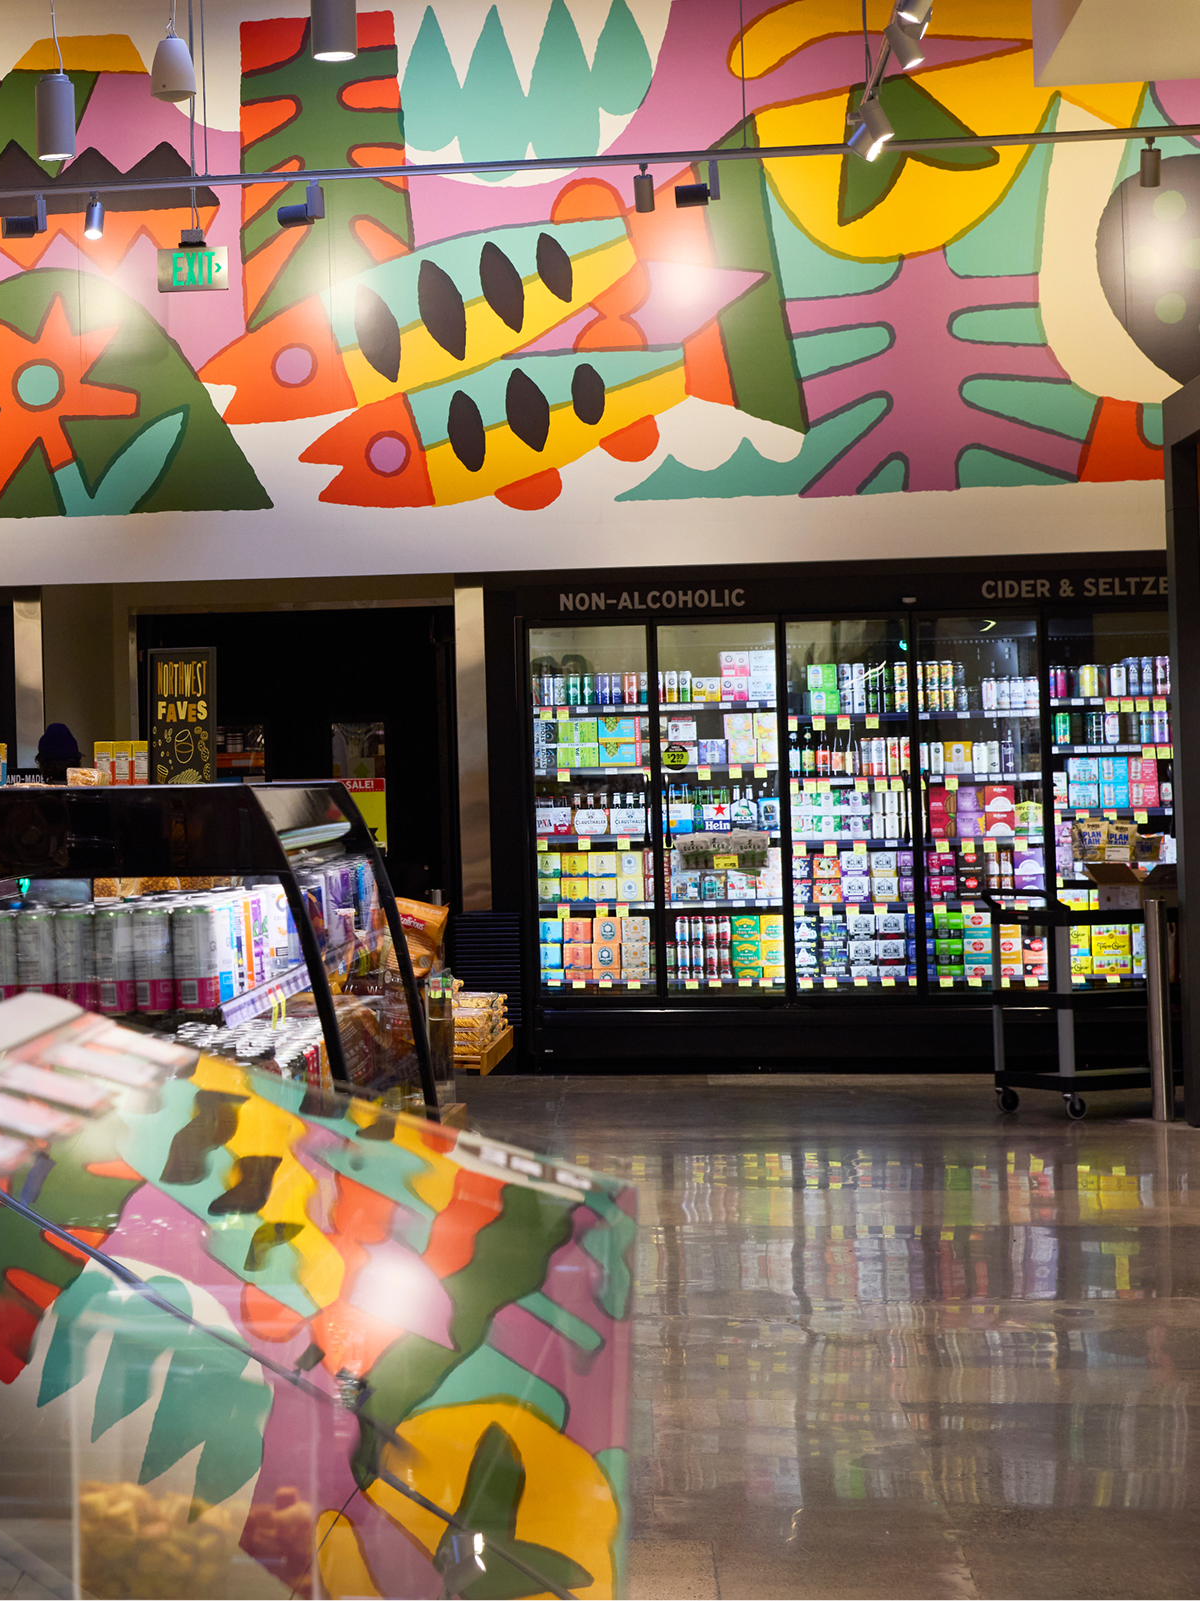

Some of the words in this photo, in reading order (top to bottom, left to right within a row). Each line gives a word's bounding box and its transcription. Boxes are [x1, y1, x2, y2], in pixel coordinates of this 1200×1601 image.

[172, 251, 215, 286] EXIT
[981, 579, 1051, 599] CIDER
[1058, 578, 1075, 598] &
[1083, 576, 1169, 597] SELTZE
[559, 588, 746, 612] NON-ALCOHOLIC
[157, 660, 207, 698] NORTHWEST
[157, 700, 208, 723] FAVES
[6, 774, 45, 784] AND-MADE
[345, 780, 375, 790] SALE!
